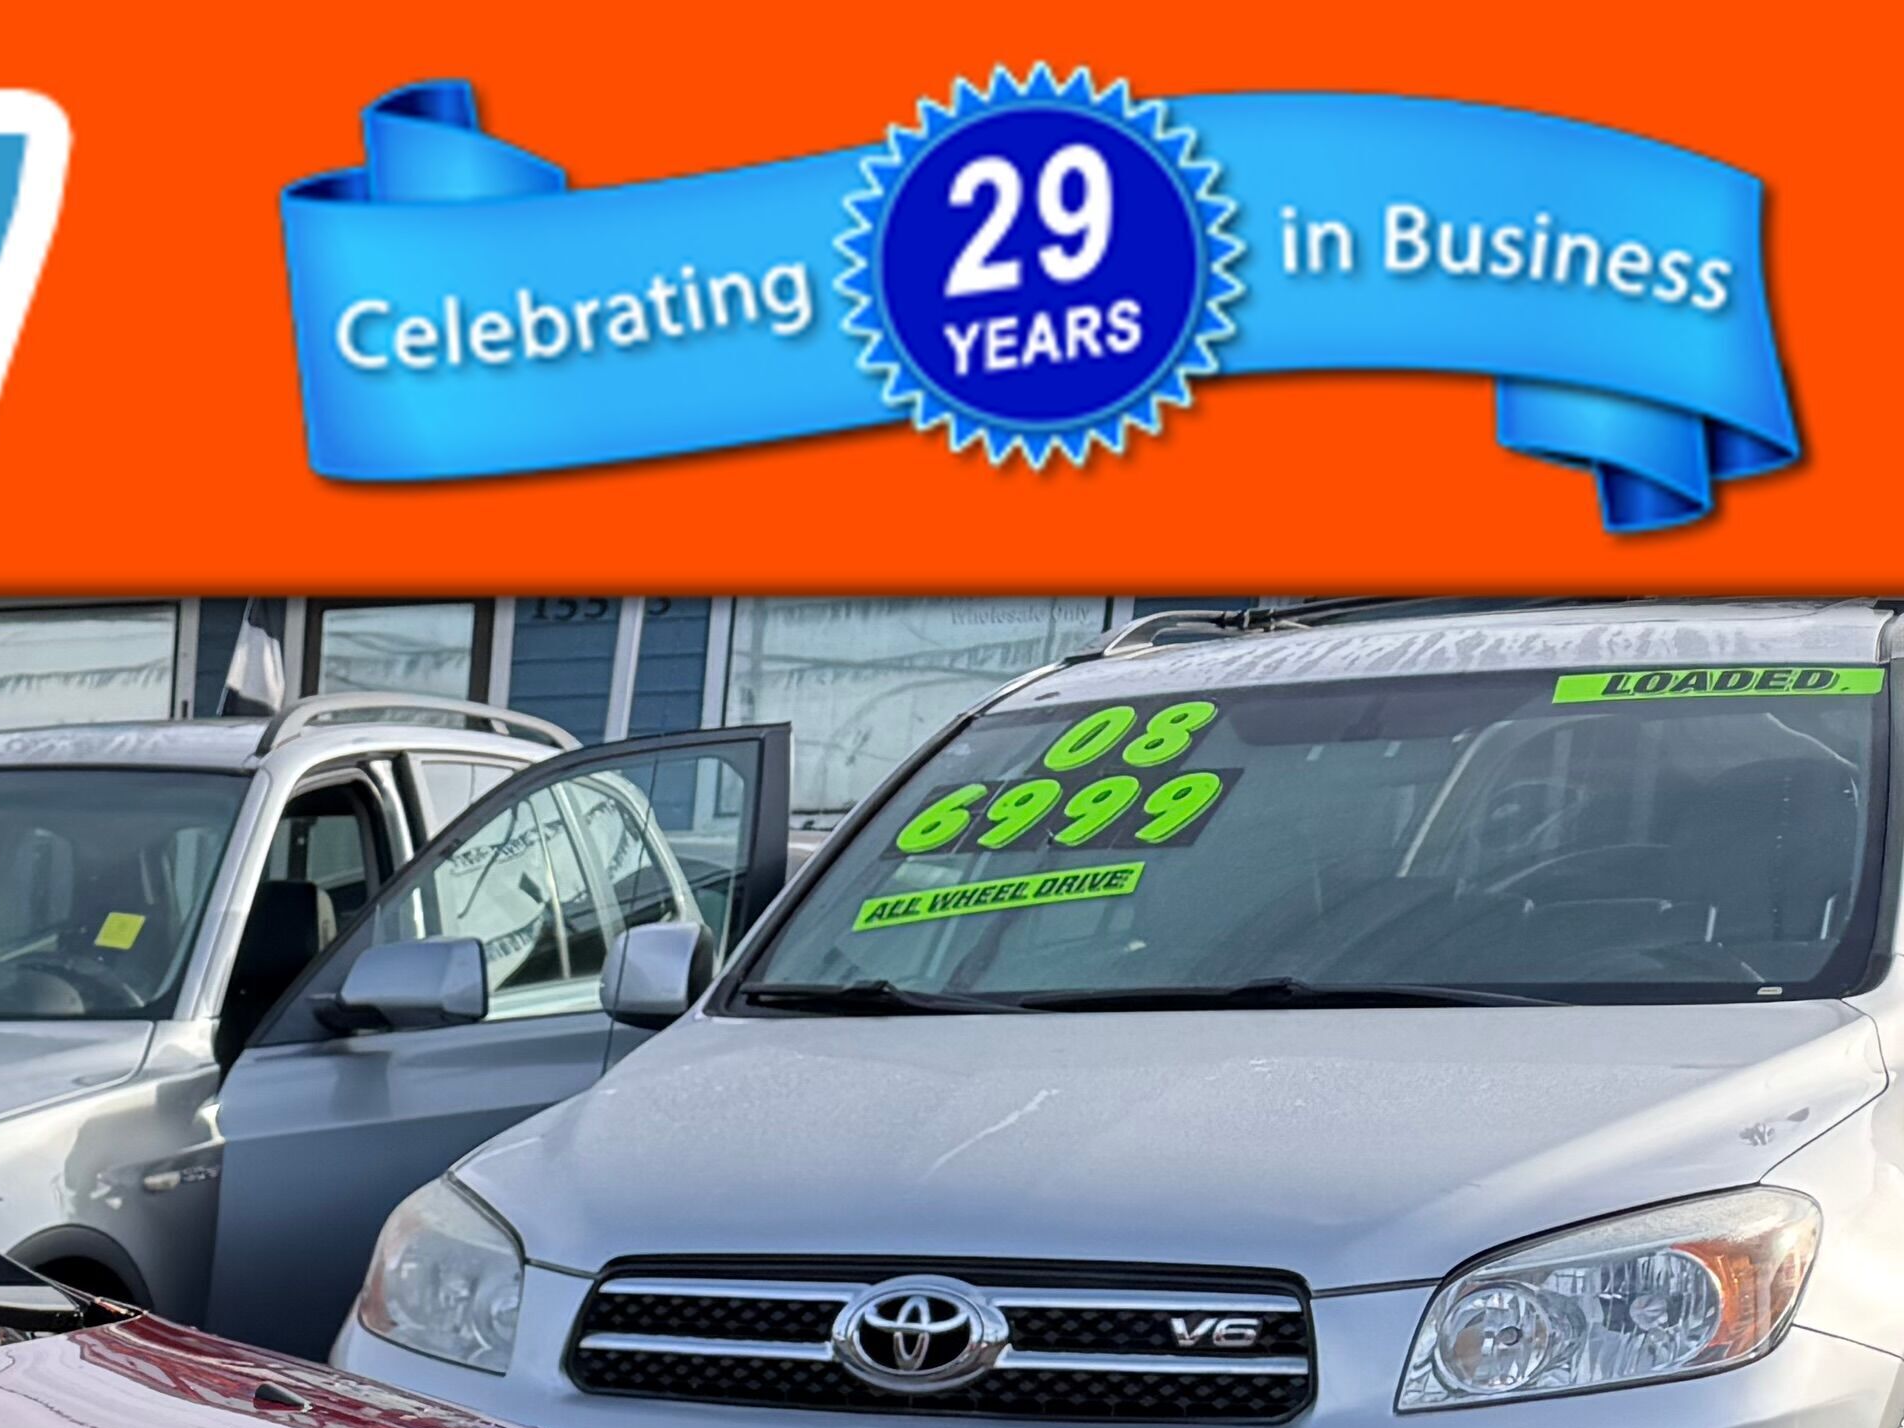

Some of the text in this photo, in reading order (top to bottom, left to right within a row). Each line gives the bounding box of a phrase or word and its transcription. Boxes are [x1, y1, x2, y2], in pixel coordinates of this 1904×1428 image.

[1600, 668, 1842, 697] LOADED
[1043, 700, 1219, 773] 08
[895, 771, 1224, 854] 6999
[862, 867, 1136, 926] ALL WHEEL DRIVE
[1170, 1317, 1260, 1348] V6
